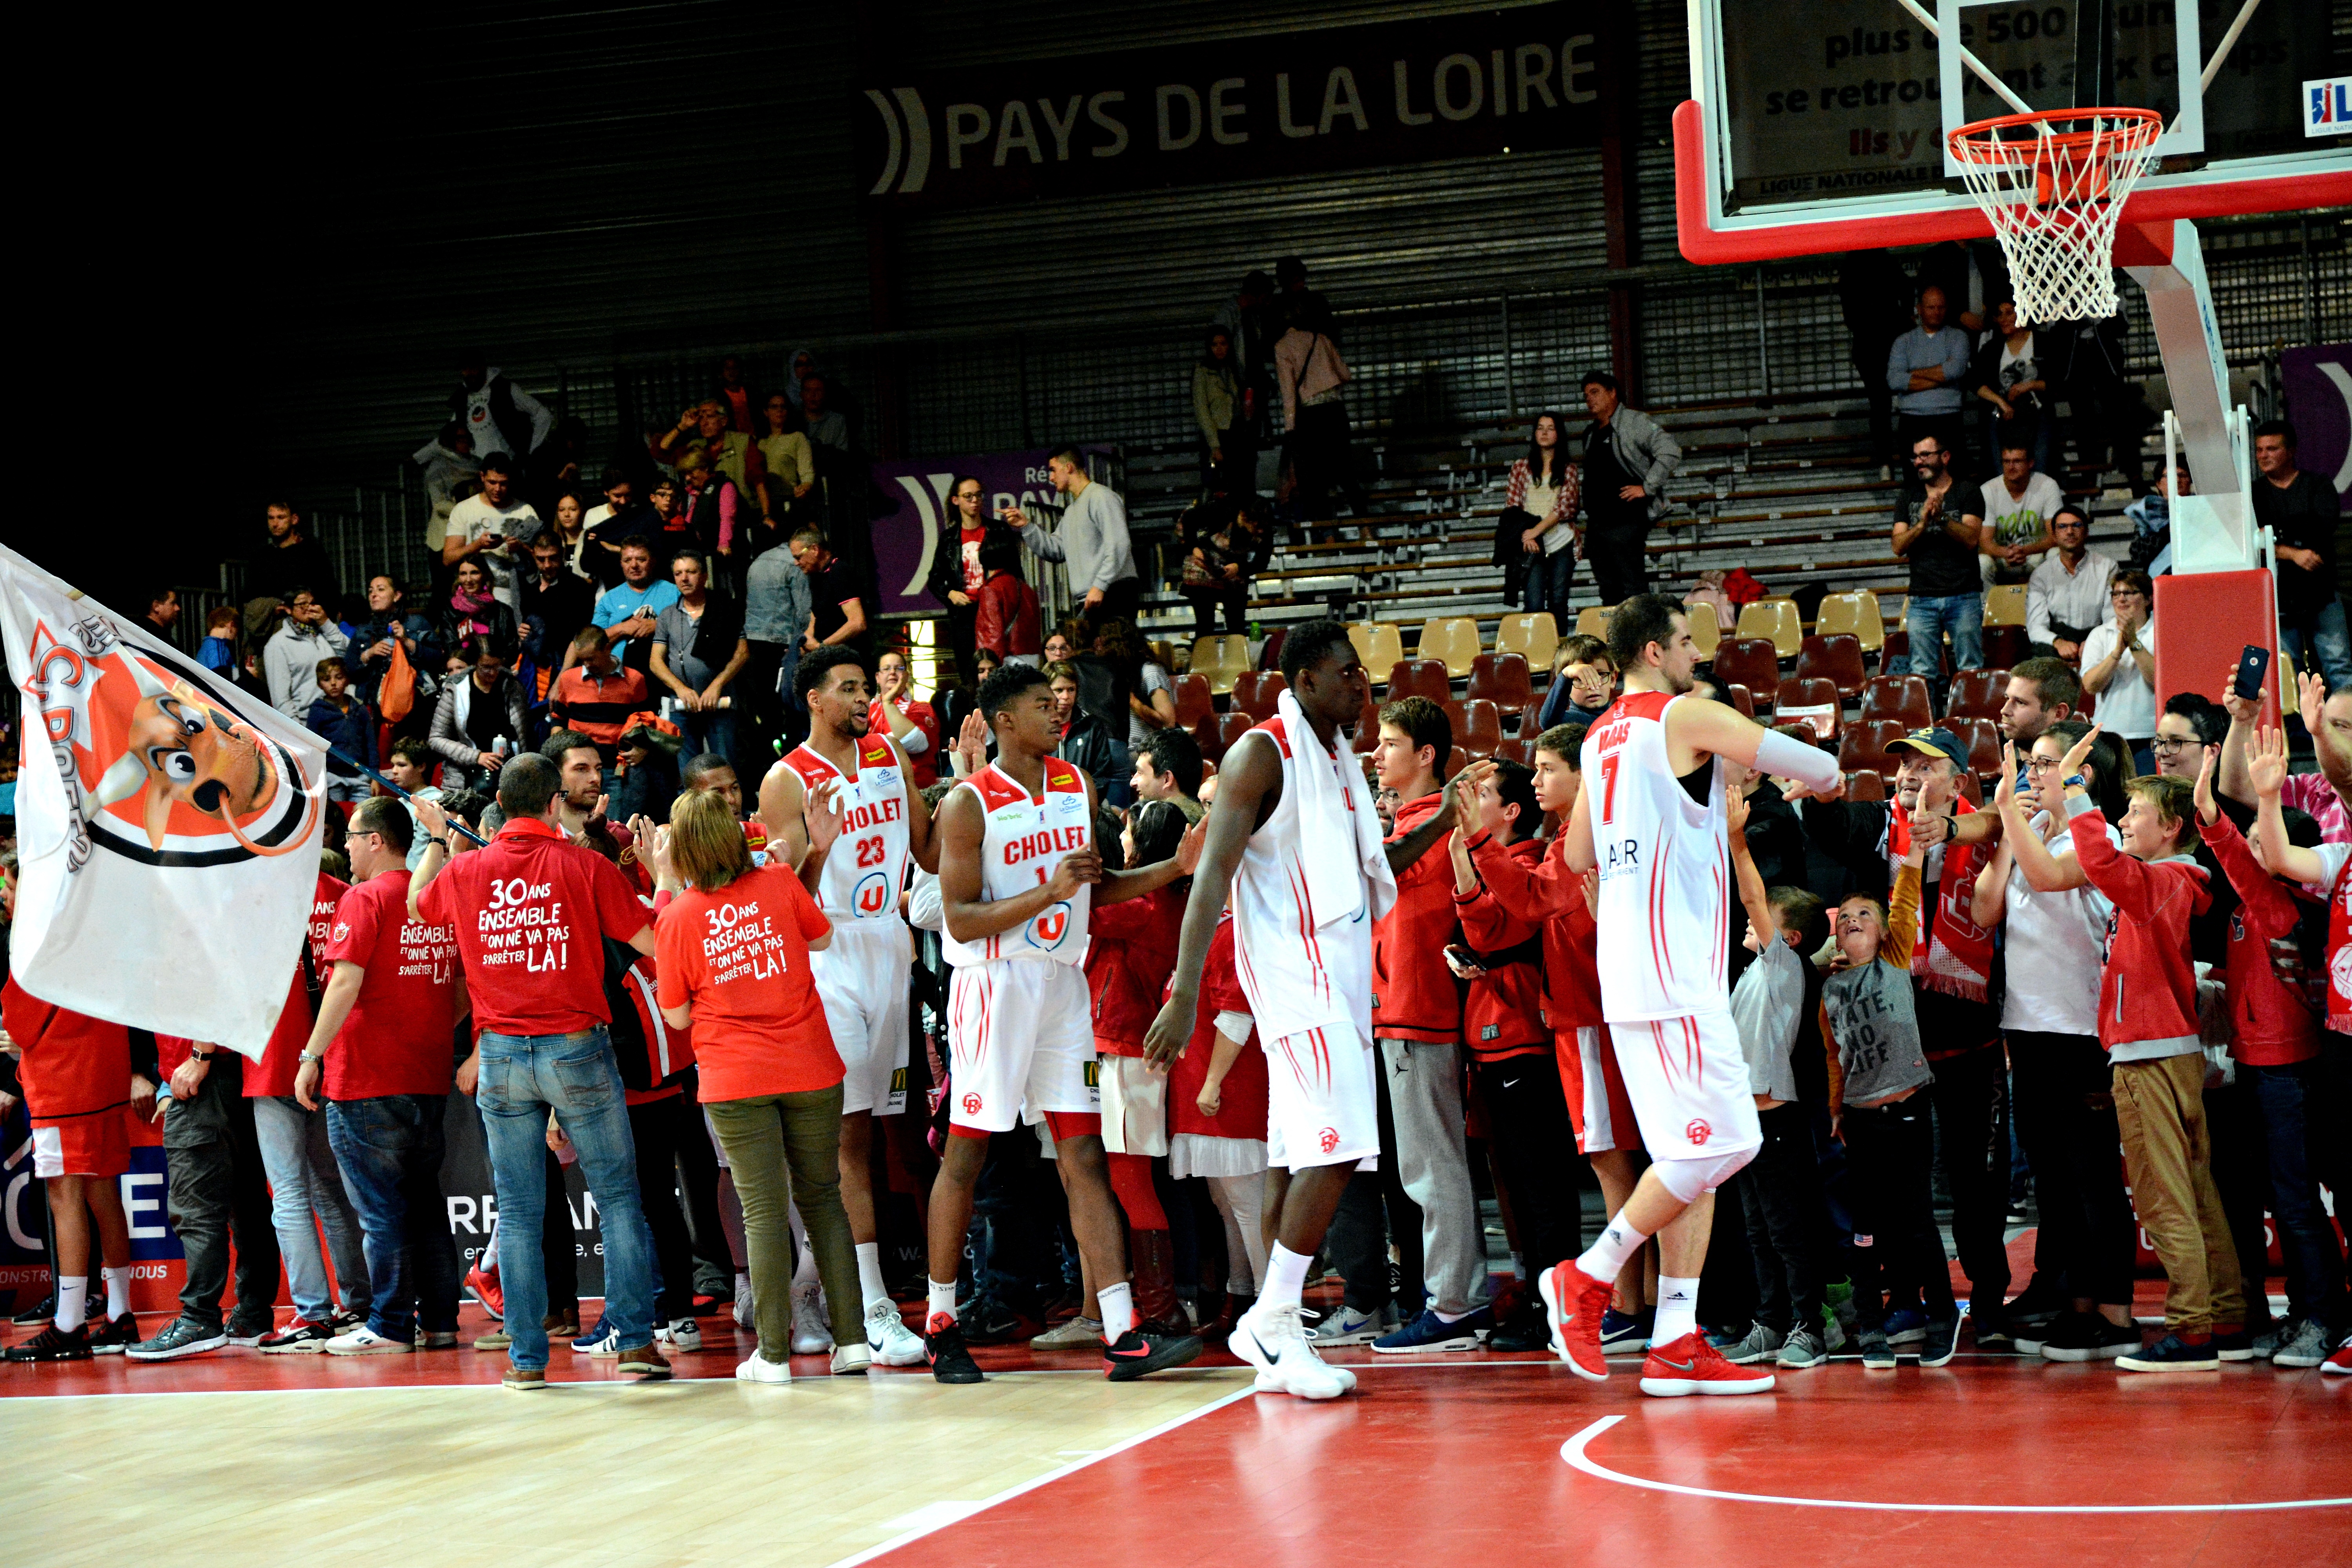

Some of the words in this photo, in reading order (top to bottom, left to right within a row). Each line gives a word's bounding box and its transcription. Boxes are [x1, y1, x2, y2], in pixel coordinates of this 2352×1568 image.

[1826, 26, 1910, 69] plus
[1987, 6, 2067, 44] 500
[946, 90, 1129, 169] PAYS
[1156, 78, 1249, 151] DE
[1276, 67, 1369, 138] LA
[1394, 34, 1598, 127] LOIRE
[1766, 89, 1809, 115] se
[1820, 60, 2047, 111] retrouent
[1849, 128, 1889, 156] Ils
[2311, 126, 2332, 134] LIGUE
[1760, 174, 1813, 195] LIGUE
[1817, 167, 1920, 190] NATIONALE
[1601, 751, 1620, 826] 7
[840, 797, 901, 836] HOLET
[855, 834, 886, 869] 23
[1004, 825, 1085, 866] CHOLET
[488, 877, 528, 909] 30
[527, 882, 552, 900] ANS
[314, 901, 336, 915] ANS
[478, 903, 562, 932] ENSEMBLE
[705, 903, 738, 936] 30
[738, 901, 759, 920] ANS
[400, 924, 454, 945] ENSEMBLE
[480, 934, 488, 942] ET
[487, 935, 504, 949] ON
[505, 929, 522, 947] NE
[525, 929, 543, 945] VA
[546, 926, 570, 942] PAS
[702, 916, 773, 957] ENSEMBLE
[400, 947, 408, 955] ET
[408, 949, 419, 961] ON
[418, 945, 429, 960] NE
[432, 946, 444, 960] VA
[446, 944, 458, 957] PAS
[482, 949, 526, 965] S'ARRÊTER
[709, 957, 717, 966] ET
[717, 953, 731, 969] ON
[731, 945, 746, 962] NE
[747, 941, 762, 958] VA
[762, 934, 784, 951] PAS
[398, 963, 432, 976] S'ARRÊTER
[714, 962, 753, 985] S'ARRÊTER
[1846, 990, 1894, 1028] ATE,
[1844, 1024, 1876, 1053] NO
[1098, 1285, 1127, 1299] PALDING
